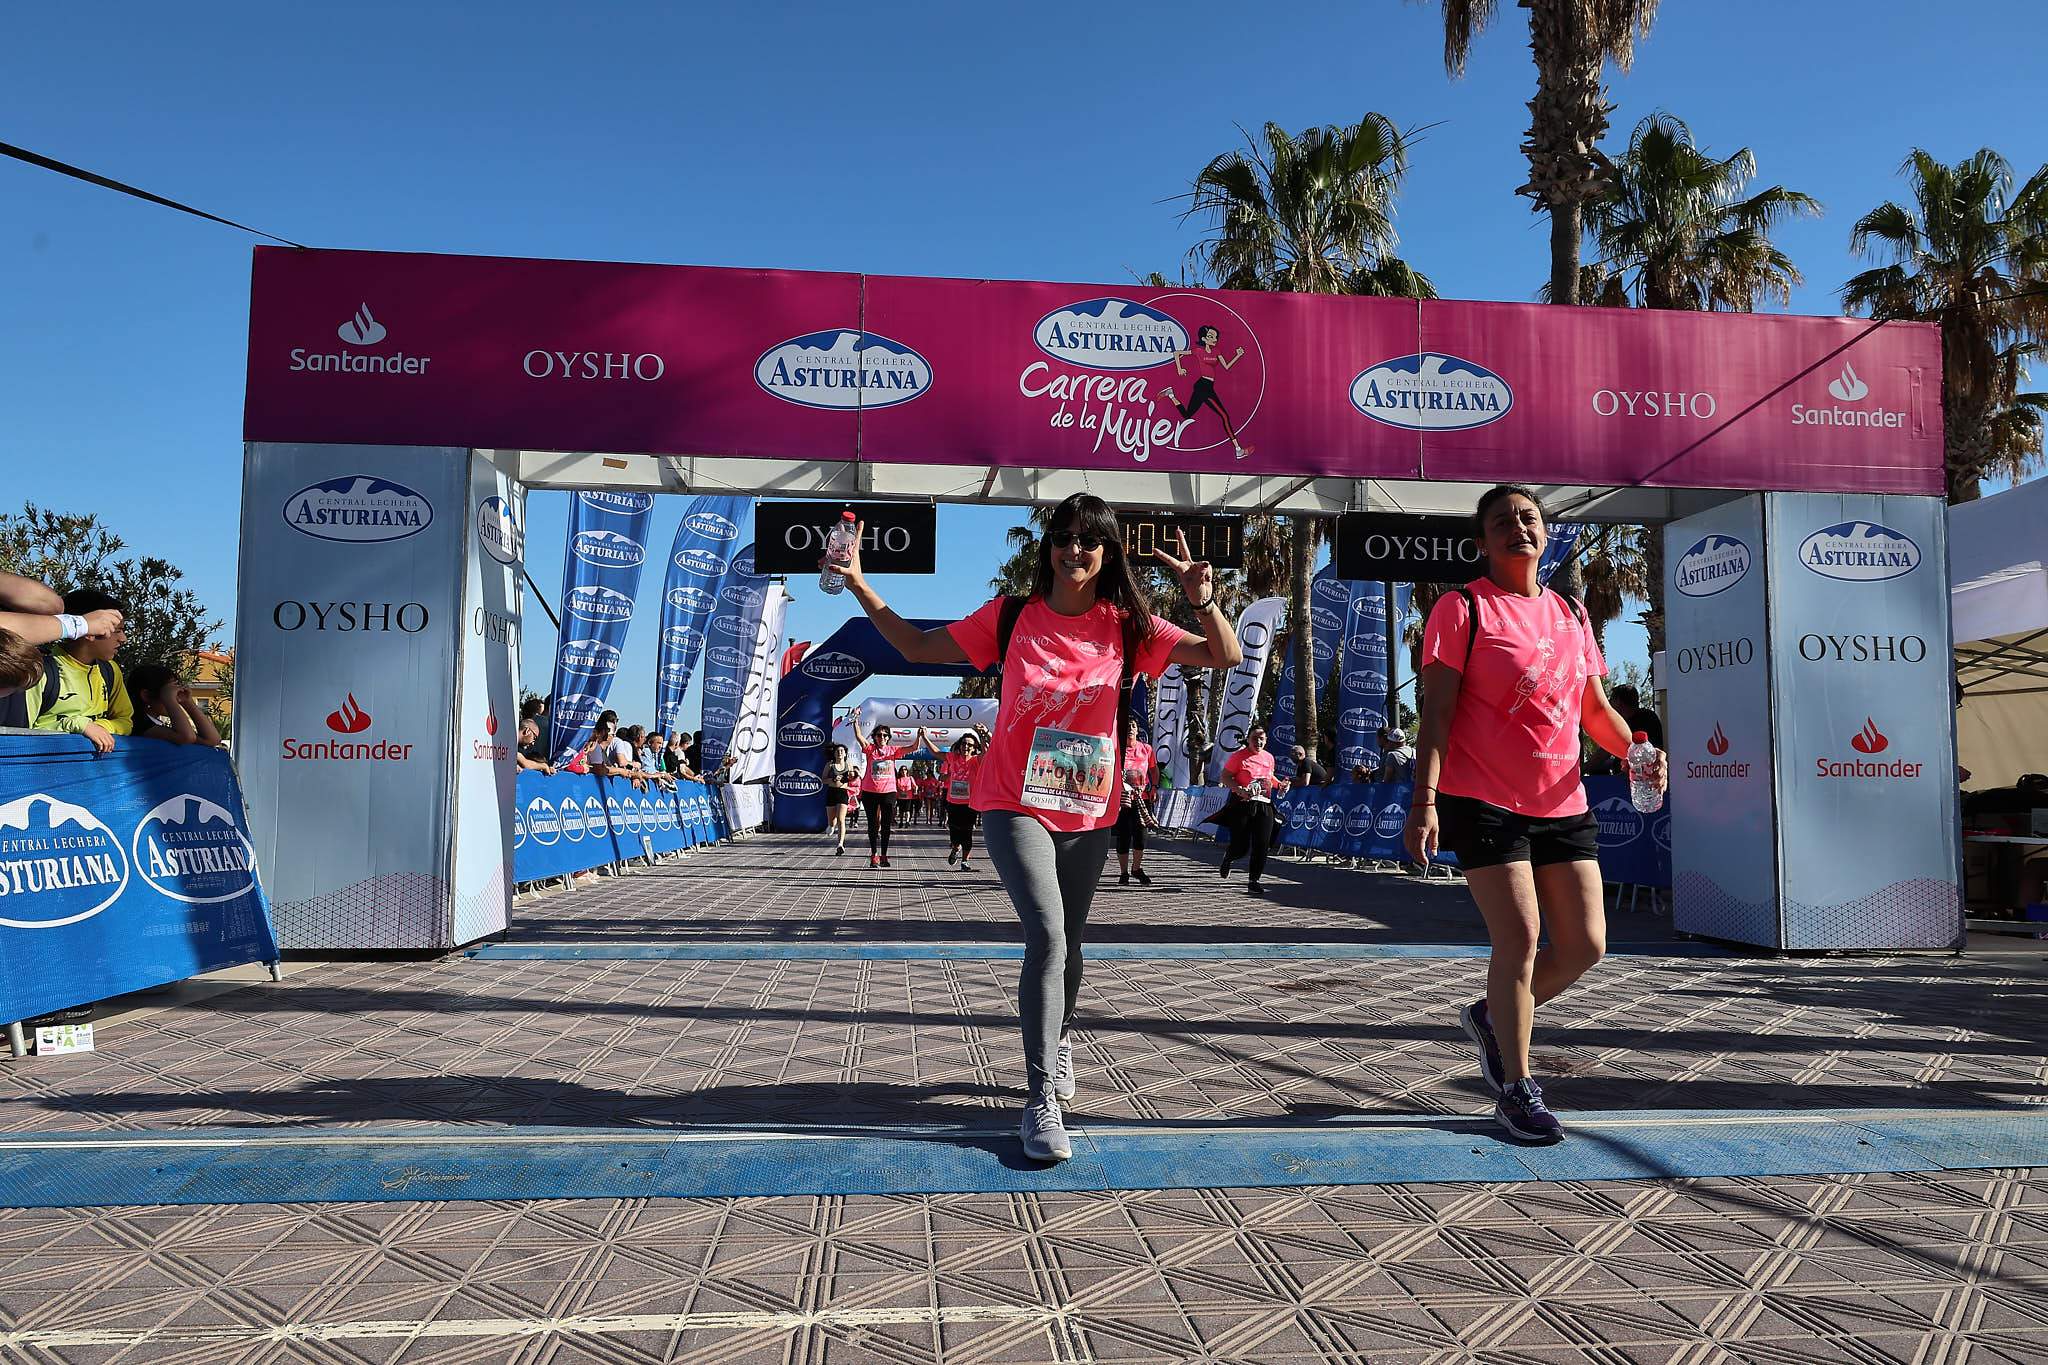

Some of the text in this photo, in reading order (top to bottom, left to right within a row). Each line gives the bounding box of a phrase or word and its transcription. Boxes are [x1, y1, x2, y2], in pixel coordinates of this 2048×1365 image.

[1046, 321, 1177, 353] ASTURIANA
[1070, 320, 1174, 333] CENTRAL LECHERA
[290, 348, 430, 374] Santander
[524, 350, 665, 381] OYSHO
[768, 356, 919, 390] ASTURIANA
[796, 356, 852, 365] CENTRAL
[1019, 361, 1148, 404] Carrera
[1387, 378, 1495, 389] CENTRAL LECHERA
[1362, 379, 1501, 412] ASTURIANA
[1592, 390, 1717, 419] OYSHO
[1791, 404, 1906, 428] Santander
[1050, 400, 1196, 462] de la Mujer
[294, 499, 422, 527] ASTURIANA
[318, 498, 367, 506] CENTRAL
[690, 518, 734, 538] ASTURIANA
[784, 524, 911, 552] OYHO
[575, 538, 640, 562] ASTURIANA
[1365, 534, 1480, 563] OYSHO
[1807, 542, 1913, 568] ASTURIANA
[1826, 541, 1908, 550] CENTRAL LECHERA
[1679, 558, 1745, 588] ASTURIANA
[274, 600, 430, 633] OYSHO
[568, 594, 630, 617] ASTURIANA
[475, 606, 516, 648] OYSHO
[1678, 637, 1754, 674] OYSHO
[1799, 634, 1927, 663] OYSHO
[806, 663, 860, 674] ASTURIANA
[1219, 621, 1268, 752] OYSHO
[894, 704, 973, 720] OYSHO
[282, 738, 413, 760] Santander
[474, 739, 508, 761] Santander
[780, 733, 822, 742] ASTURIANA
[1687, 760, 1750, 779] Santander
[1816, 758, 1922, 778] Santander
[778, 780, 820, 790] ASTURIANA
[162, 830, 240, 842] CENTRAL LECHE
[1598, 822, 1636, 836] TURIANA
[2, 836, 107, 853] ENTRAL LECHERA
[148, 835, 248, 879] ASTURIAN
[0, 852, 121, 897] STURIANA
